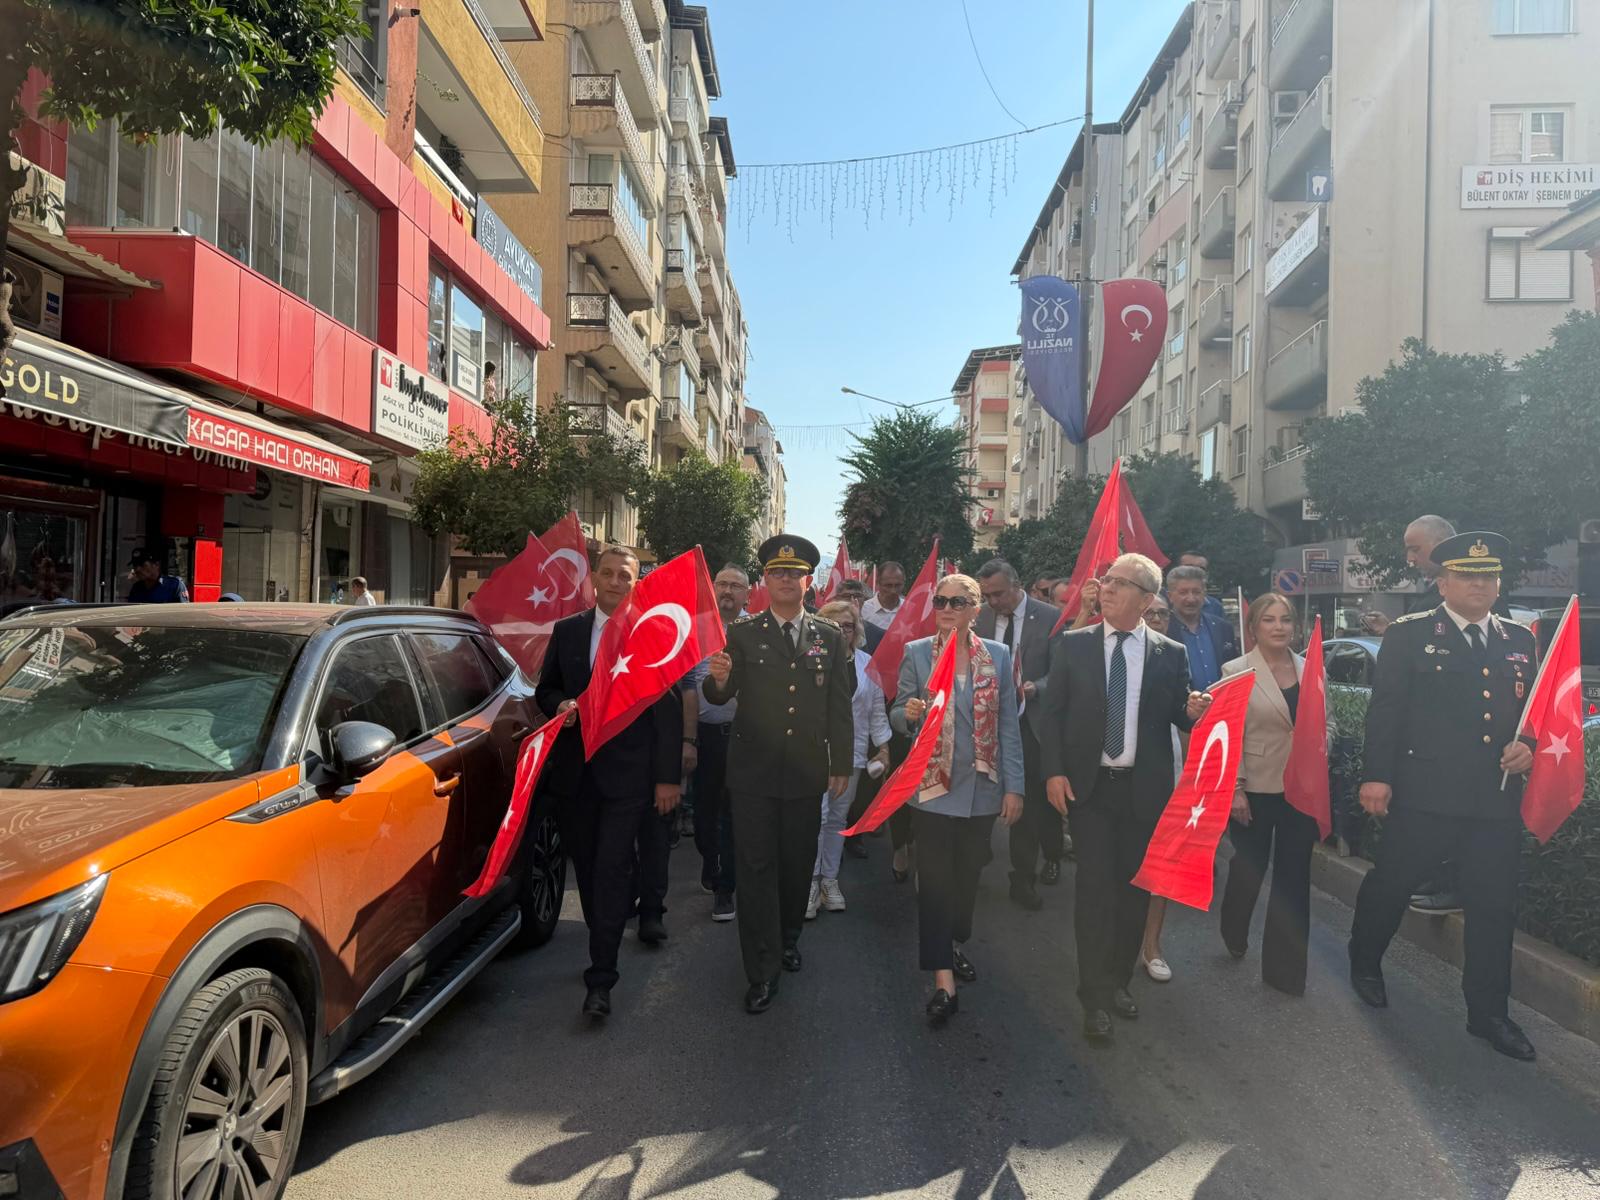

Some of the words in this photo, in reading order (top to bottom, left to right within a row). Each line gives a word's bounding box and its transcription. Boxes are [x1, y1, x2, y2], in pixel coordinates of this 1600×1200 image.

[1467, 190, 1500, 201] BÜLENT
[1502, 190, 1528, 201] OKTAY
[1536, 189, 1571, 203] ŞEBNEM
[1497, 169, 1524, 186] DİŞ
[1530, 168, 1593, 184] HEKİMİ
[504, 234, 535, 282] AVUKAT
[0, 357, 79, 405] GOLD
[187, 415, 250, 451] KASAP
[254, 436, 289, 465] HACI
[293, 448, 340, 479] ORHAN
